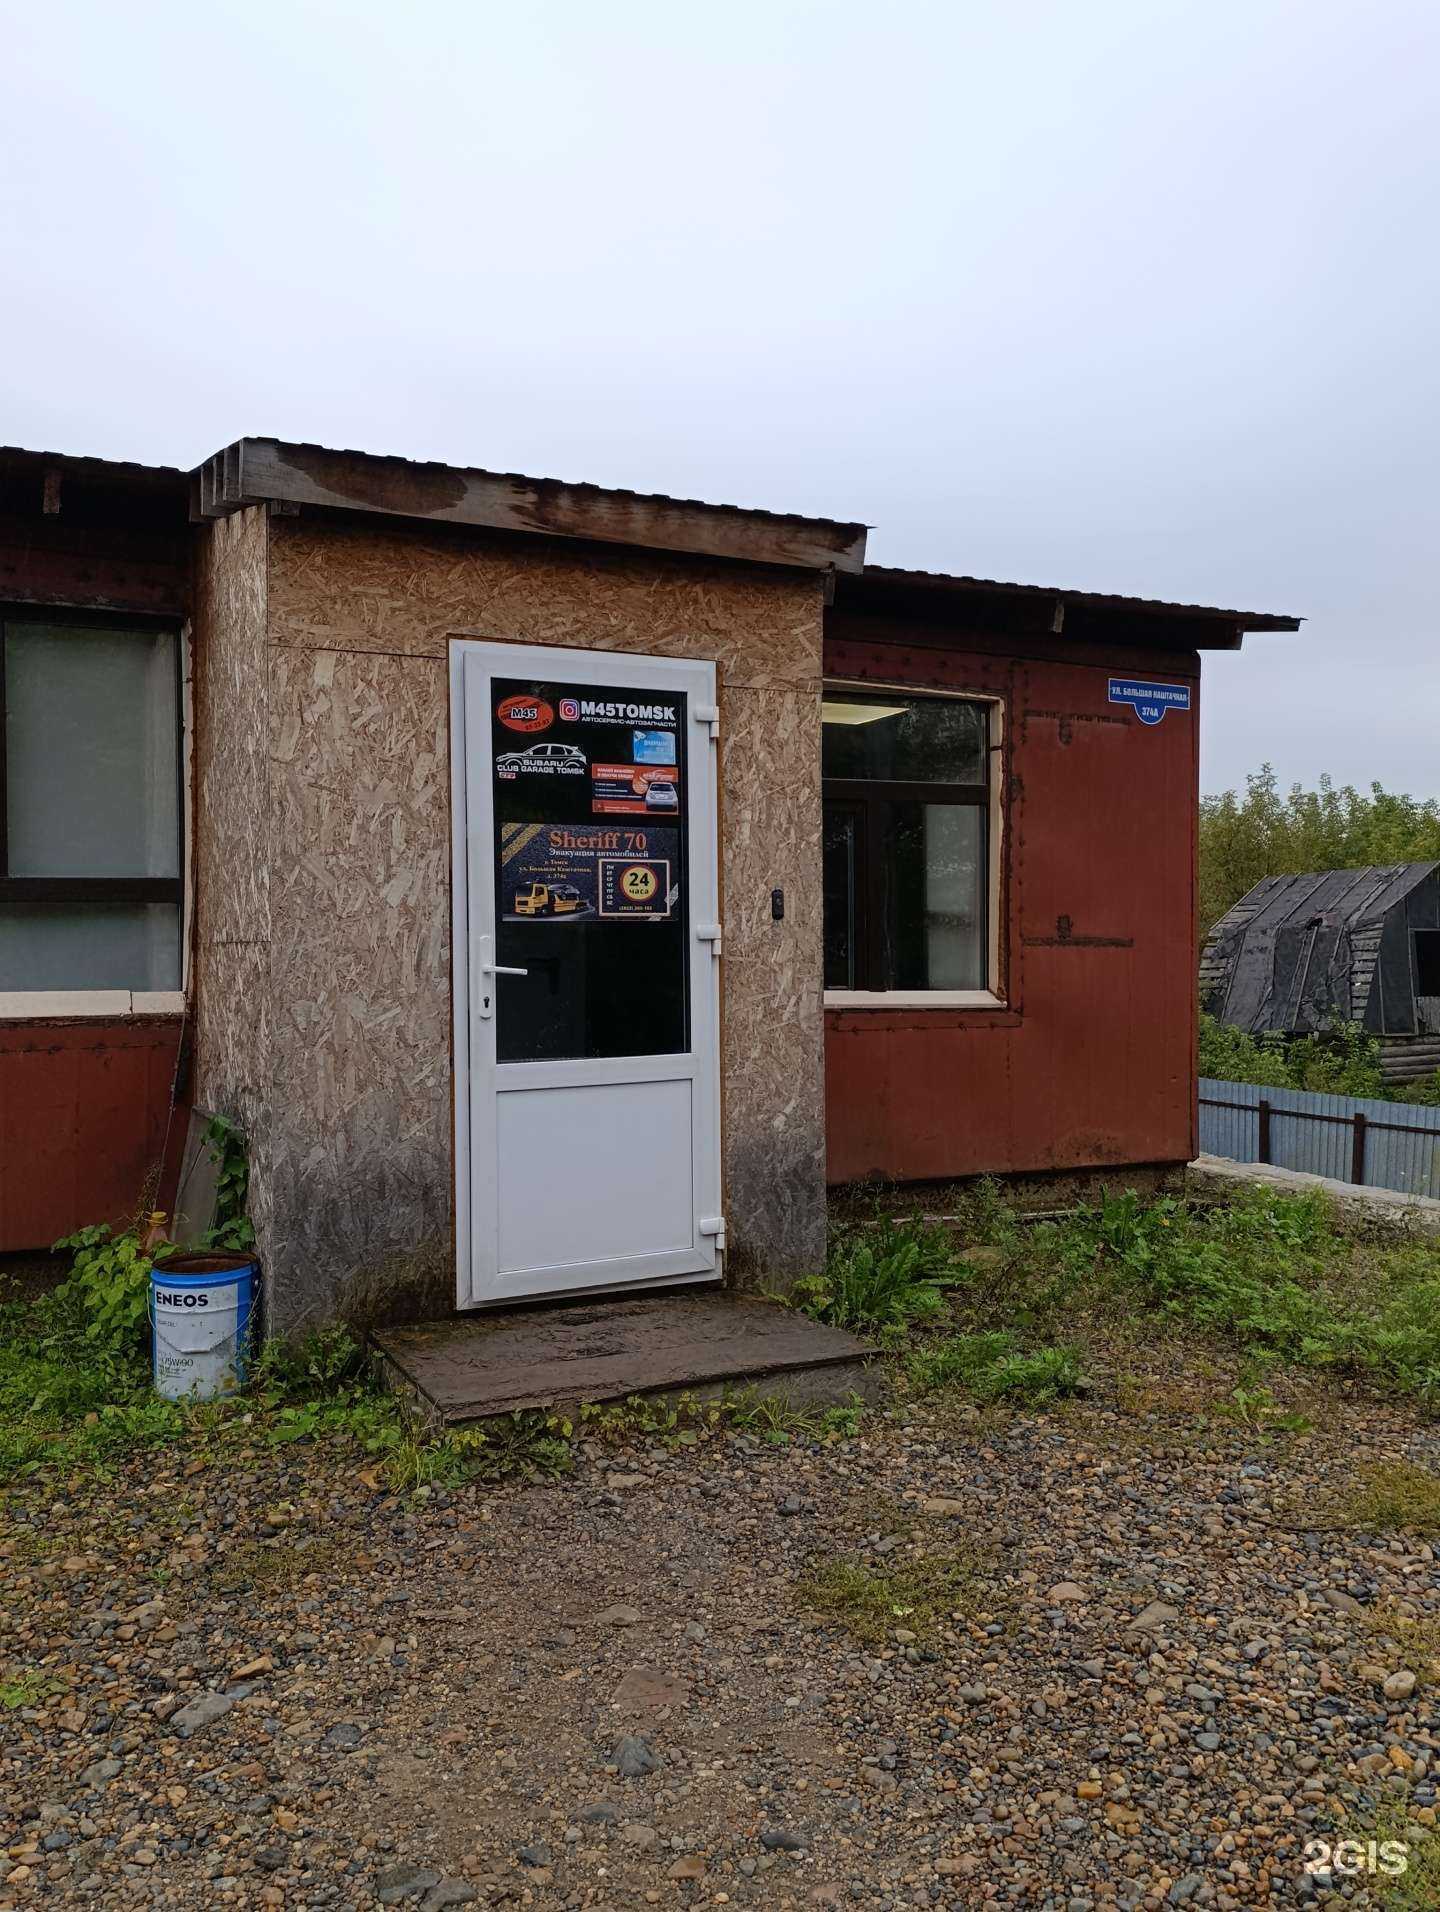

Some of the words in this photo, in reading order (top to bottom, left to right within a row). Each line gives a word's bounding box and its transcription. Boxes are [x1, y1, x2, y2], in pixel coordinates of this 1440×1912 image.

[1111, 687, 1122, 695] УЛ.
[1123, 687, 1152, 698] БОЛЬШАЯ
[511, 707, 537, 720] M45
[581, 701, 676, 720] M45TOMSK
[497, 764, 519, 772] CLUB
[521, 766, 554, 774] GARAGE
[557, 767, 585, 775] TOMSK
[523, 759, 564, 767] SUBARU
[549, 830, 620, 849] Sheriff
[624, 832, 647, 850] 70
[549, 847, 595, 858] Эвакуация
[596, 849, 649, 858] автомобилей
[629, 872, 649, 887] 24
[156, 1291, 209, 1308] ENEOS
